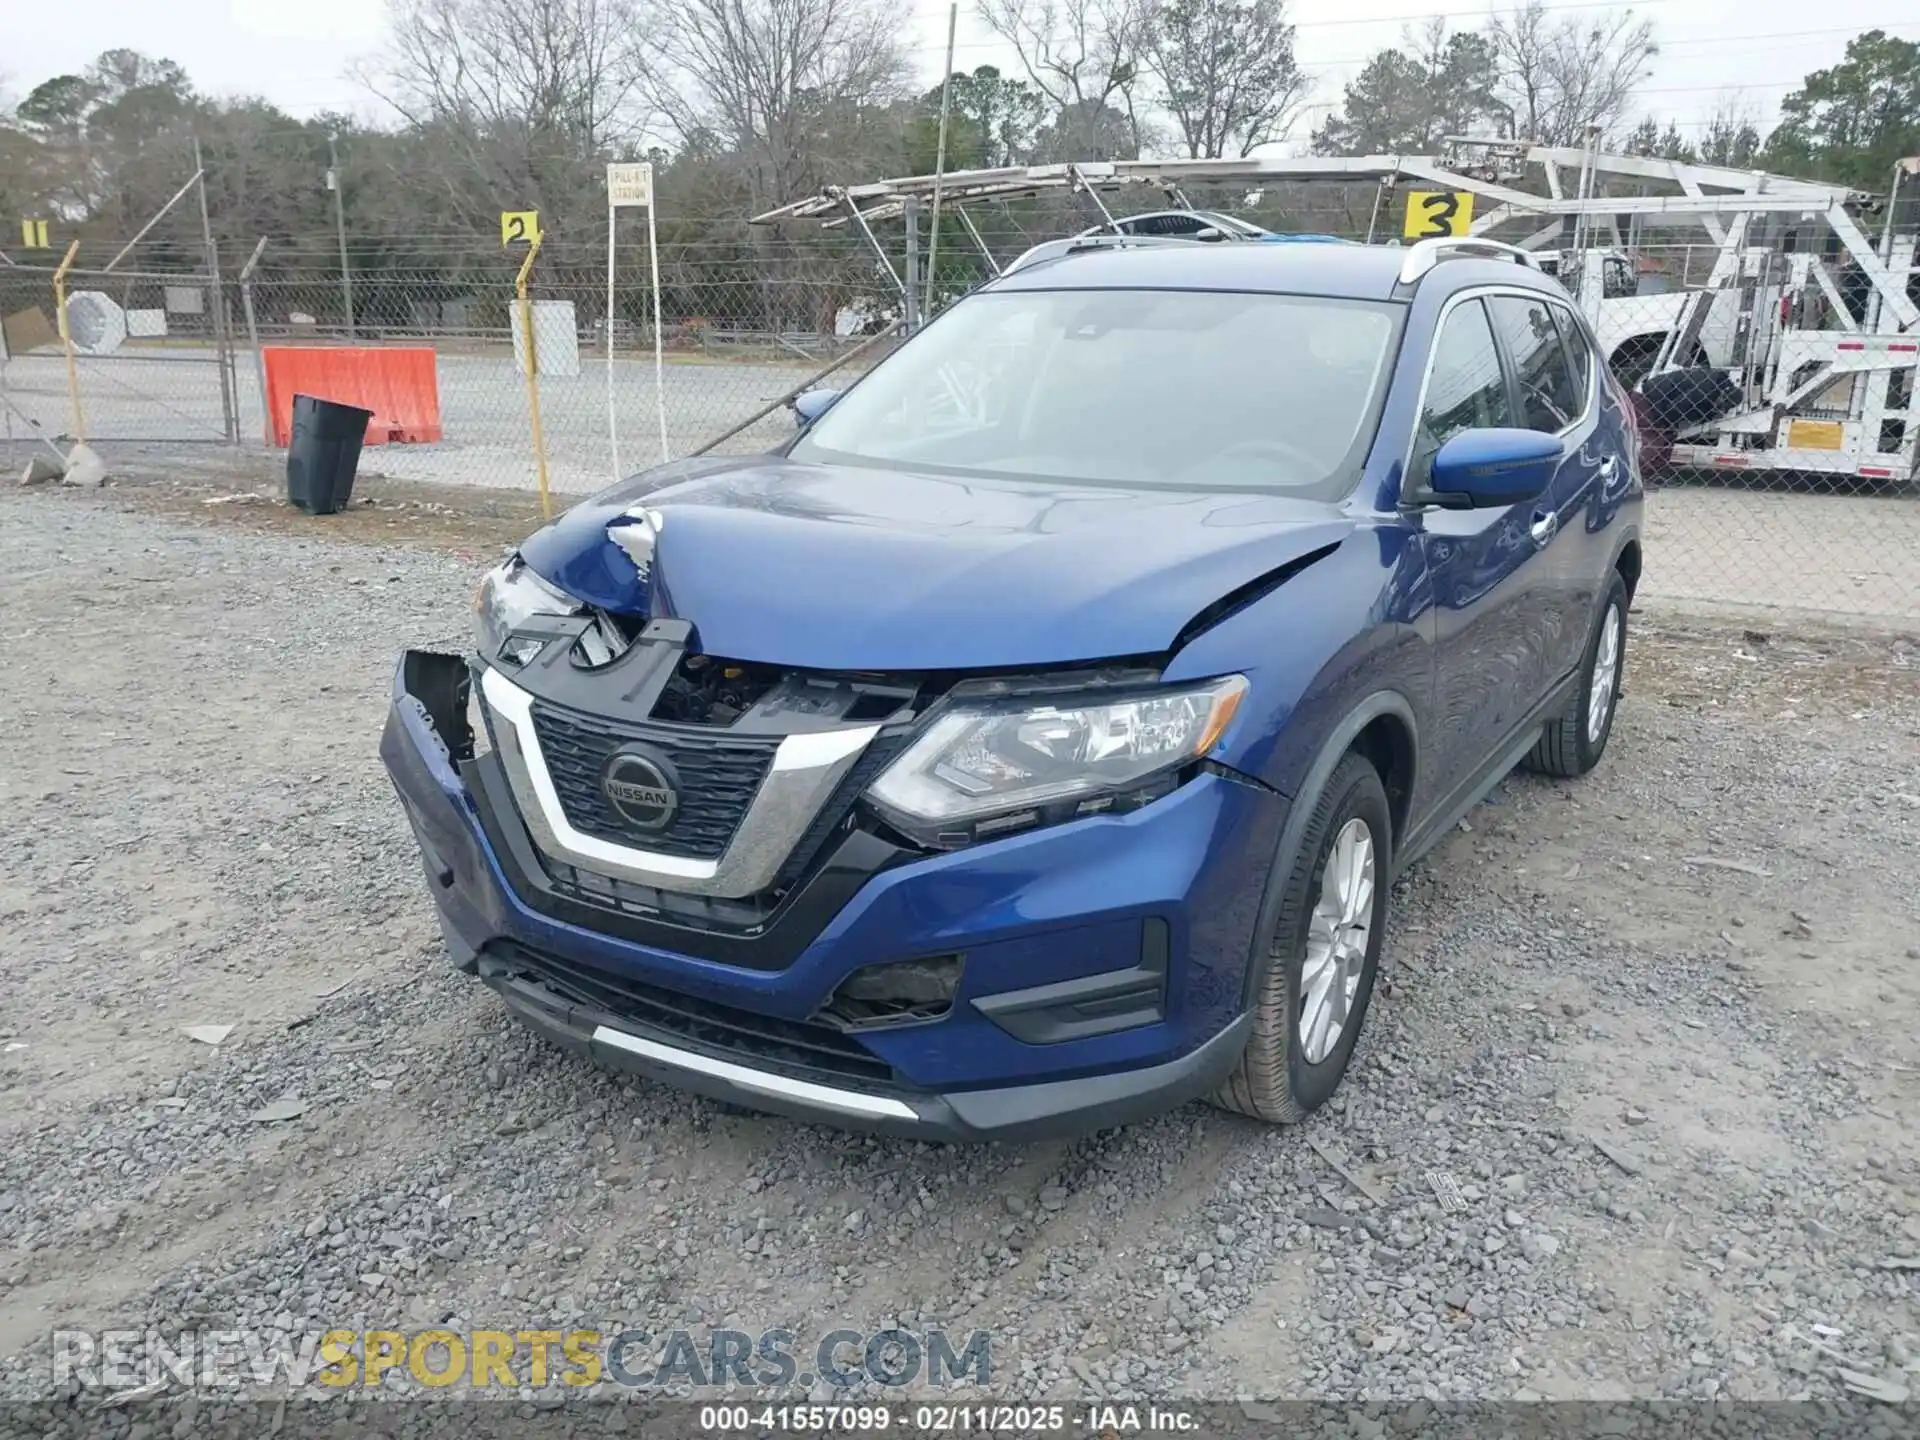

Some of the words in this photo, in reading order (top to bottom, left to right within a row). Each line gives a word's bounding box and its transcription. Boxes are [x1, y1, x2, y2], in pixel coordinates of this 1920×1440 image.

[1420, 191, 1459, 237] 3
[506, 216, 532, 245] 2
[607, 783, 668, 804] NISSAN
